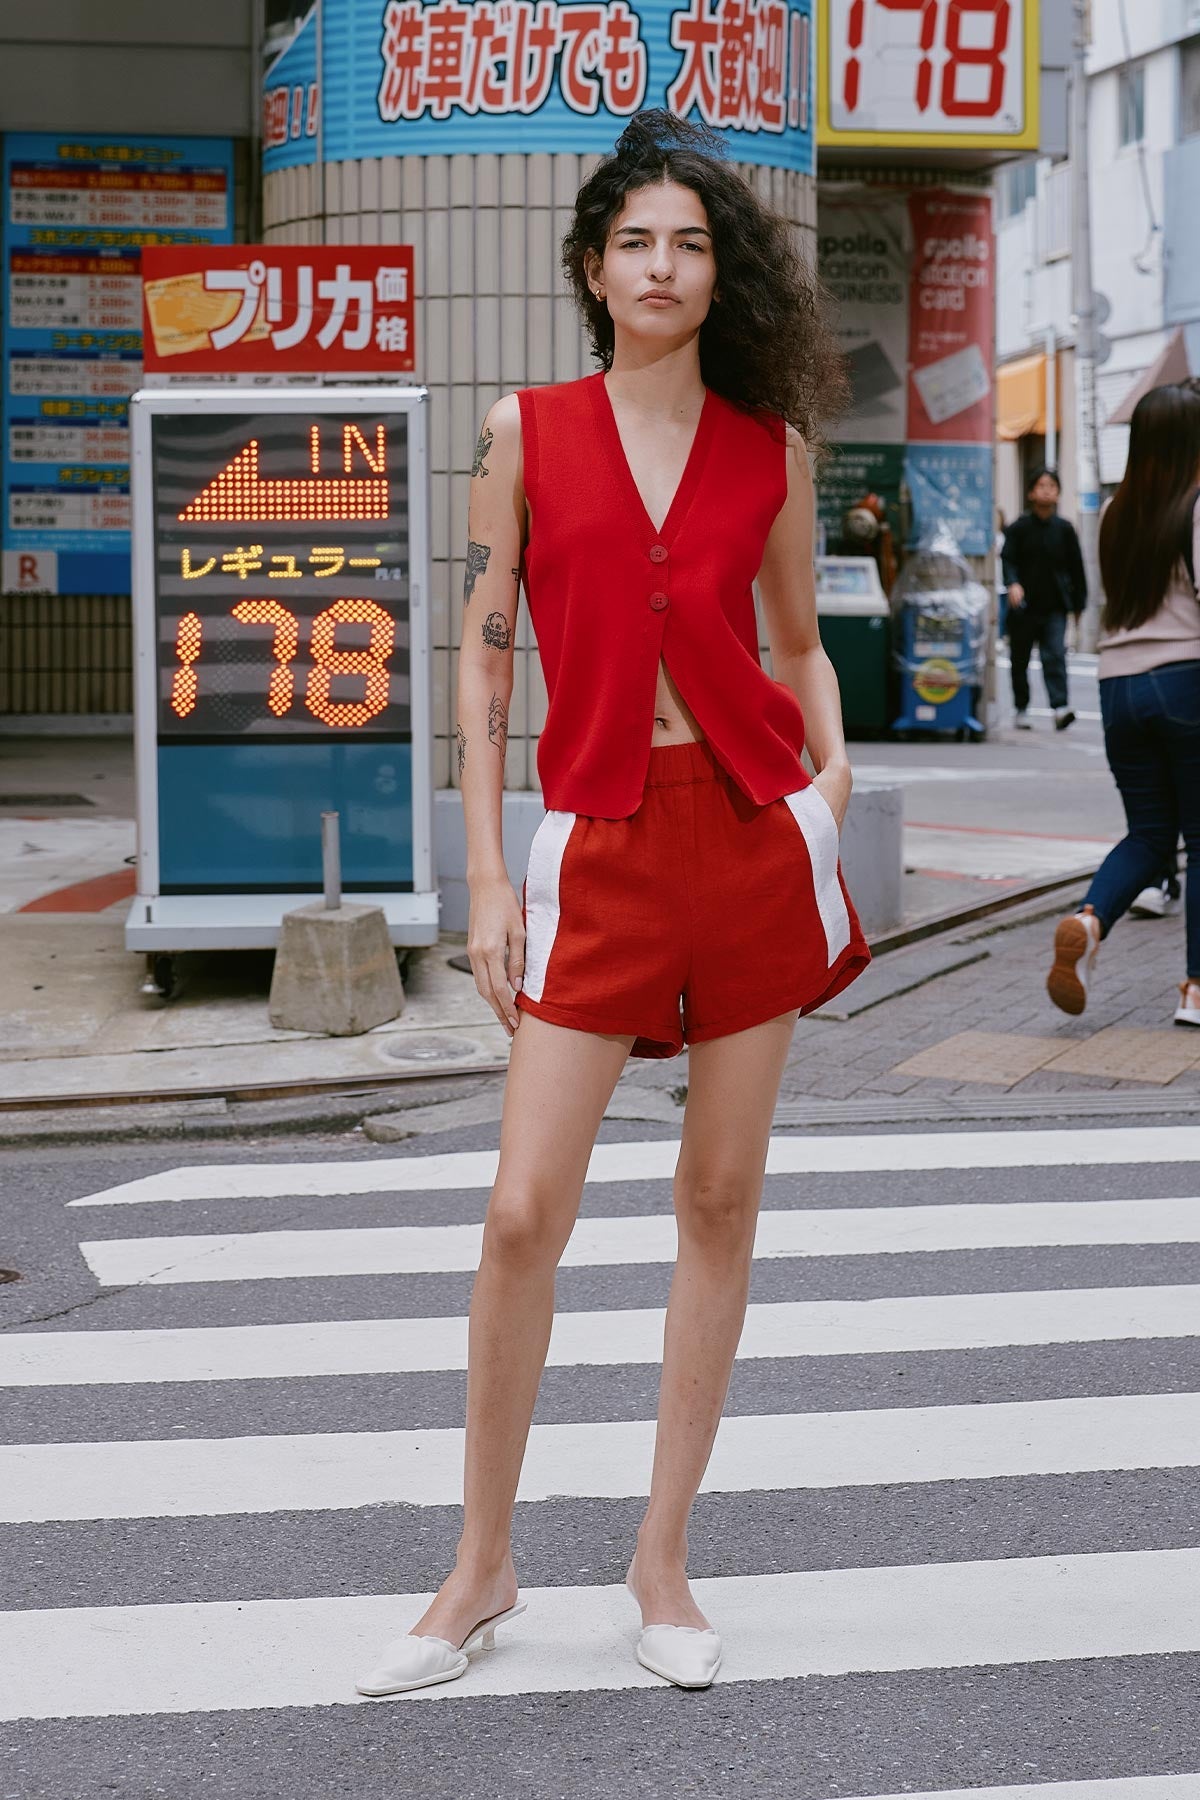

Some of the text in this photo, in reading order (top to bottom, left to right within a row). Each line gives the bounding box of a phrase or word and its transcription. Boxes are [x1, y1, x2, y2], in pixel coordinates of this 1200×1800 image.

[378, 1, 646, 120] 洗車だけでも
[844, 0, 1011, 119] 178
[205, 260, 373, 350] プリカ
[375, 266, 408, 352] 価格
[311, 424, 386, 474] IN
[181, 544, 382, 580] レギュラー
[171, 598, 396, 728] 178
